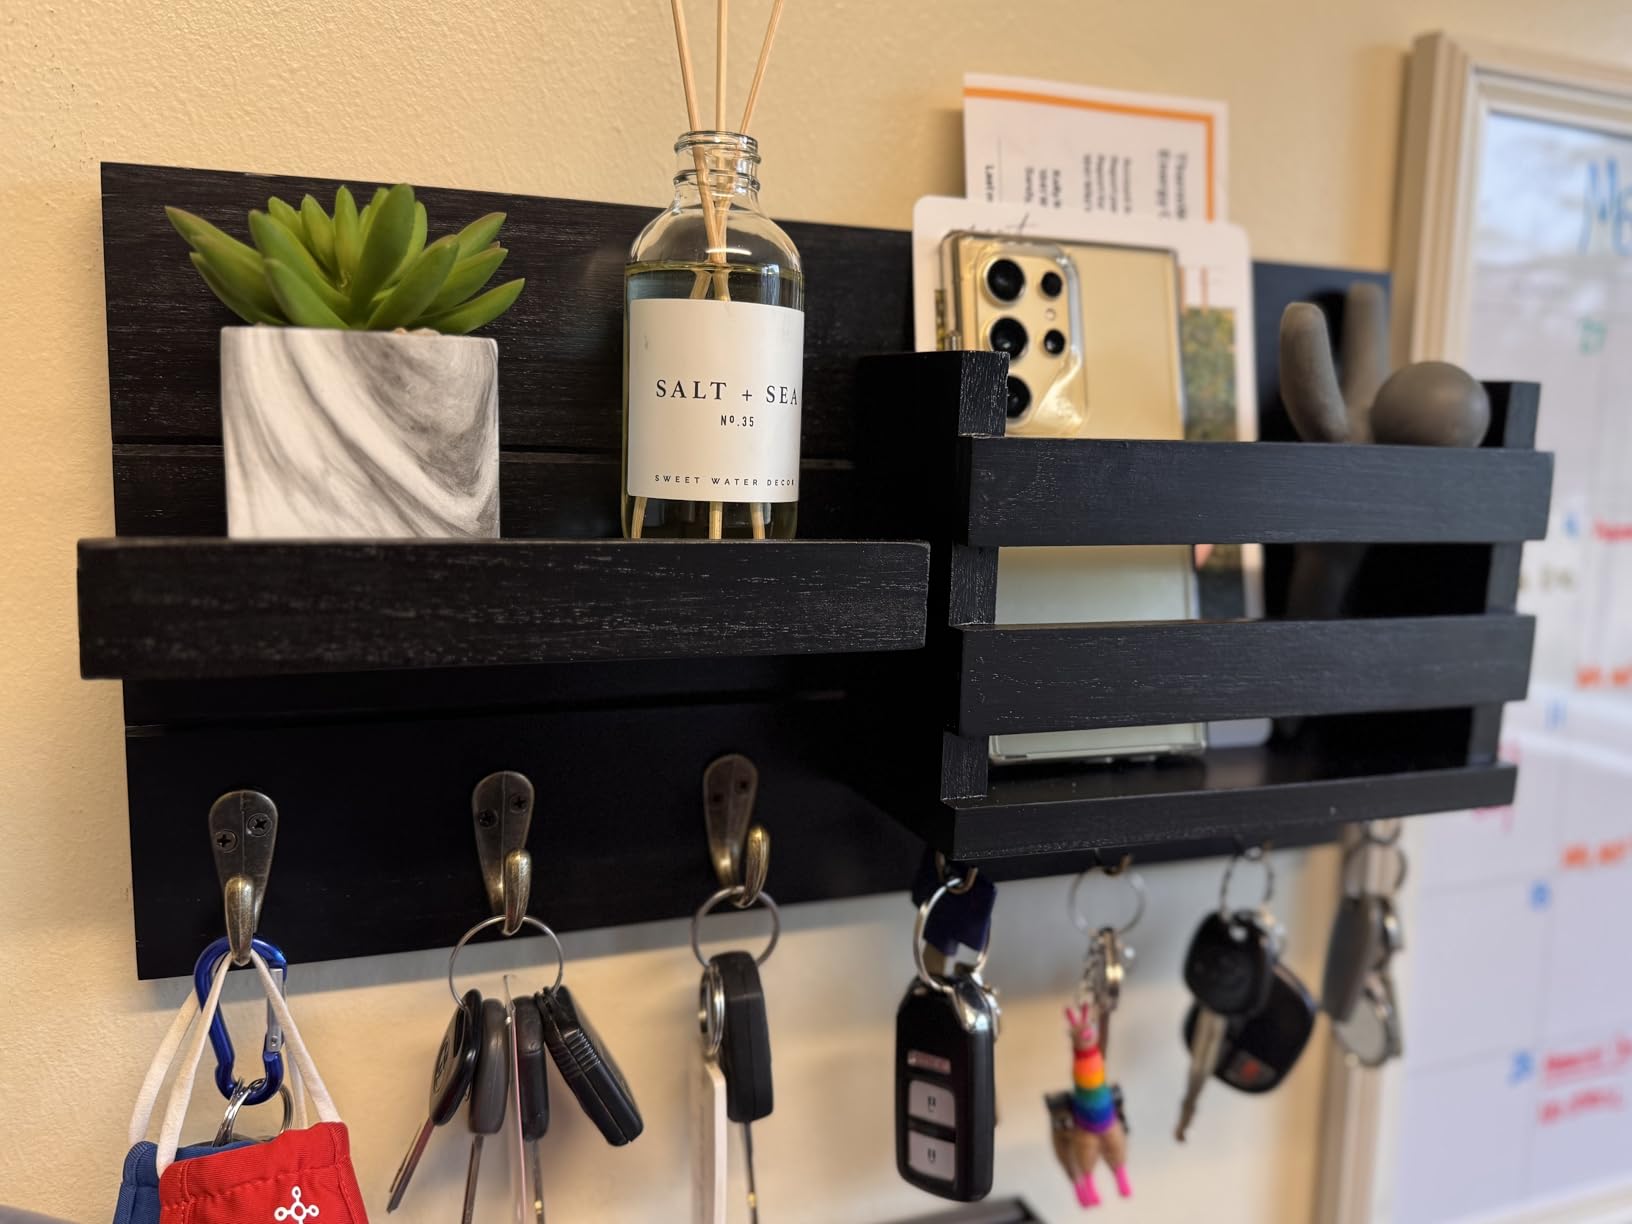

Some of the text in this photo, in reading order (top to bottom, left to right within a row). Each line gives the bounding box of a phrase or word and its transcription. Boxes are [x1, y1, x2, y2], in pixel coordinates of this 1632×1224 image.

[655, 379, 799, 405] SALT + SEA
[655, 474, 701, 484] SWEET
[711, 477, 758, 486] WATER
